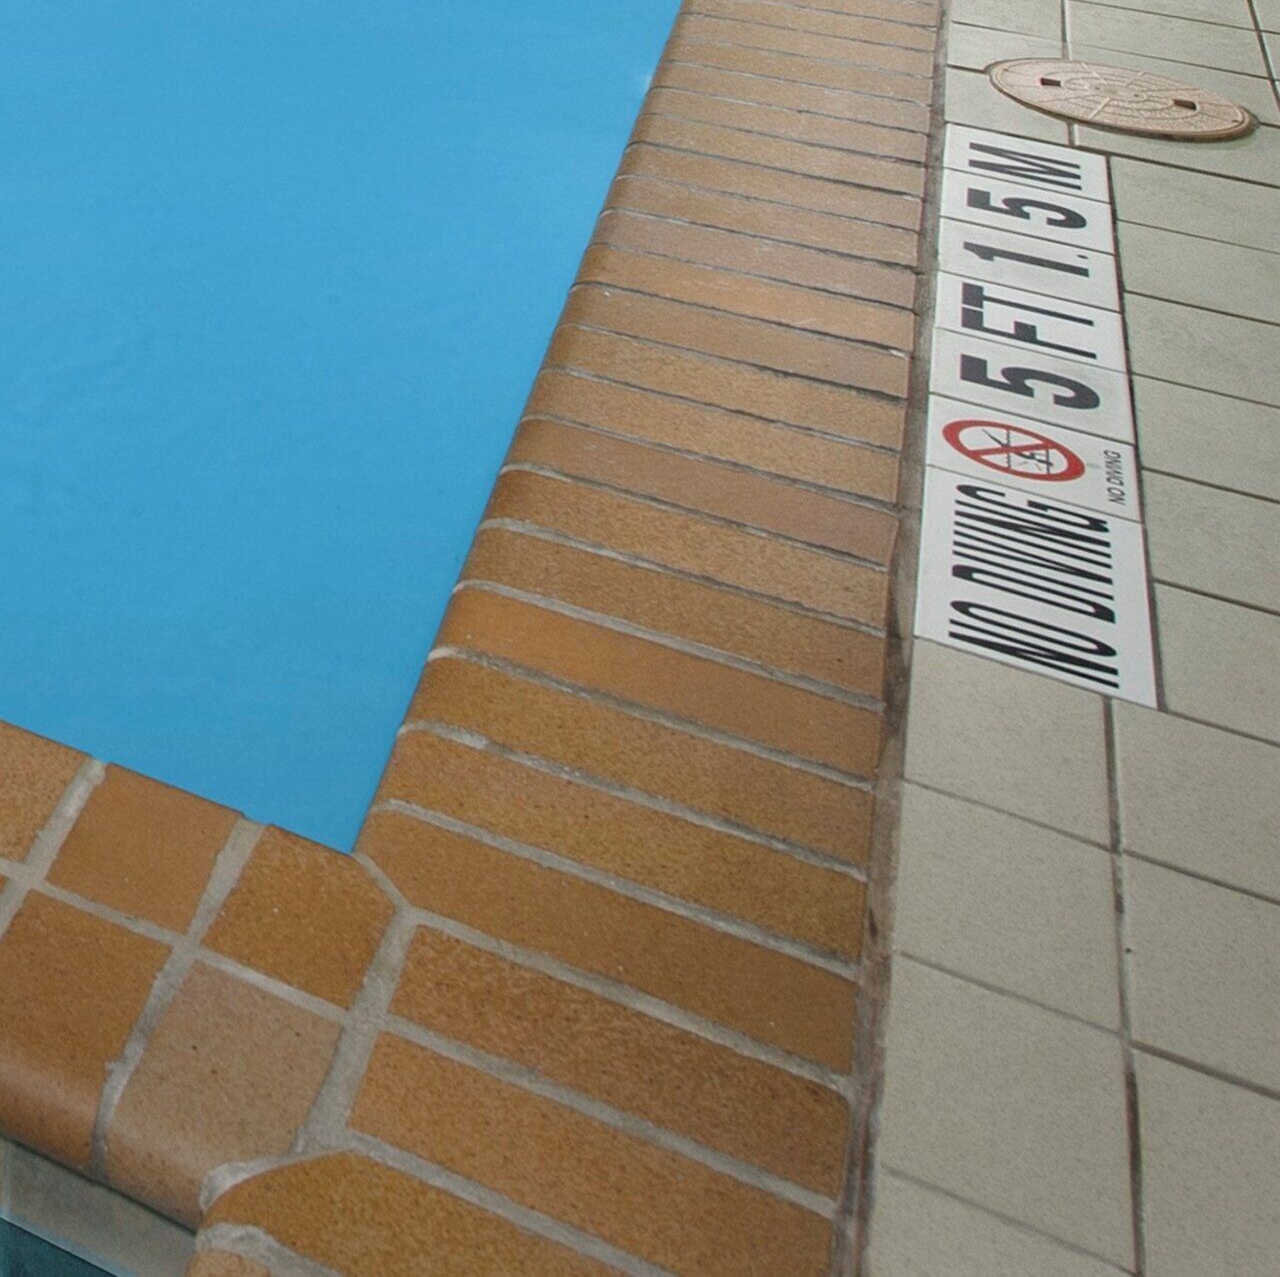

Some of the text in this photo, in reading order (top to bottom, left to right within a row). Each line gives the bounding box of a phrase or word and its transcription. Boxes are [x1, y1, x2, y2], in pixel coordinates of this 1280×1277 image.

[968, 142, 1083, 191] M
[960, 282, 1097, 360] FT
[960, 353, 1100, 410] 5
[1103, 450, 1126, 506] NO DIVING
[952, 484, 1116, 624] DIVING
[948, 600, 1120, 689] NO
